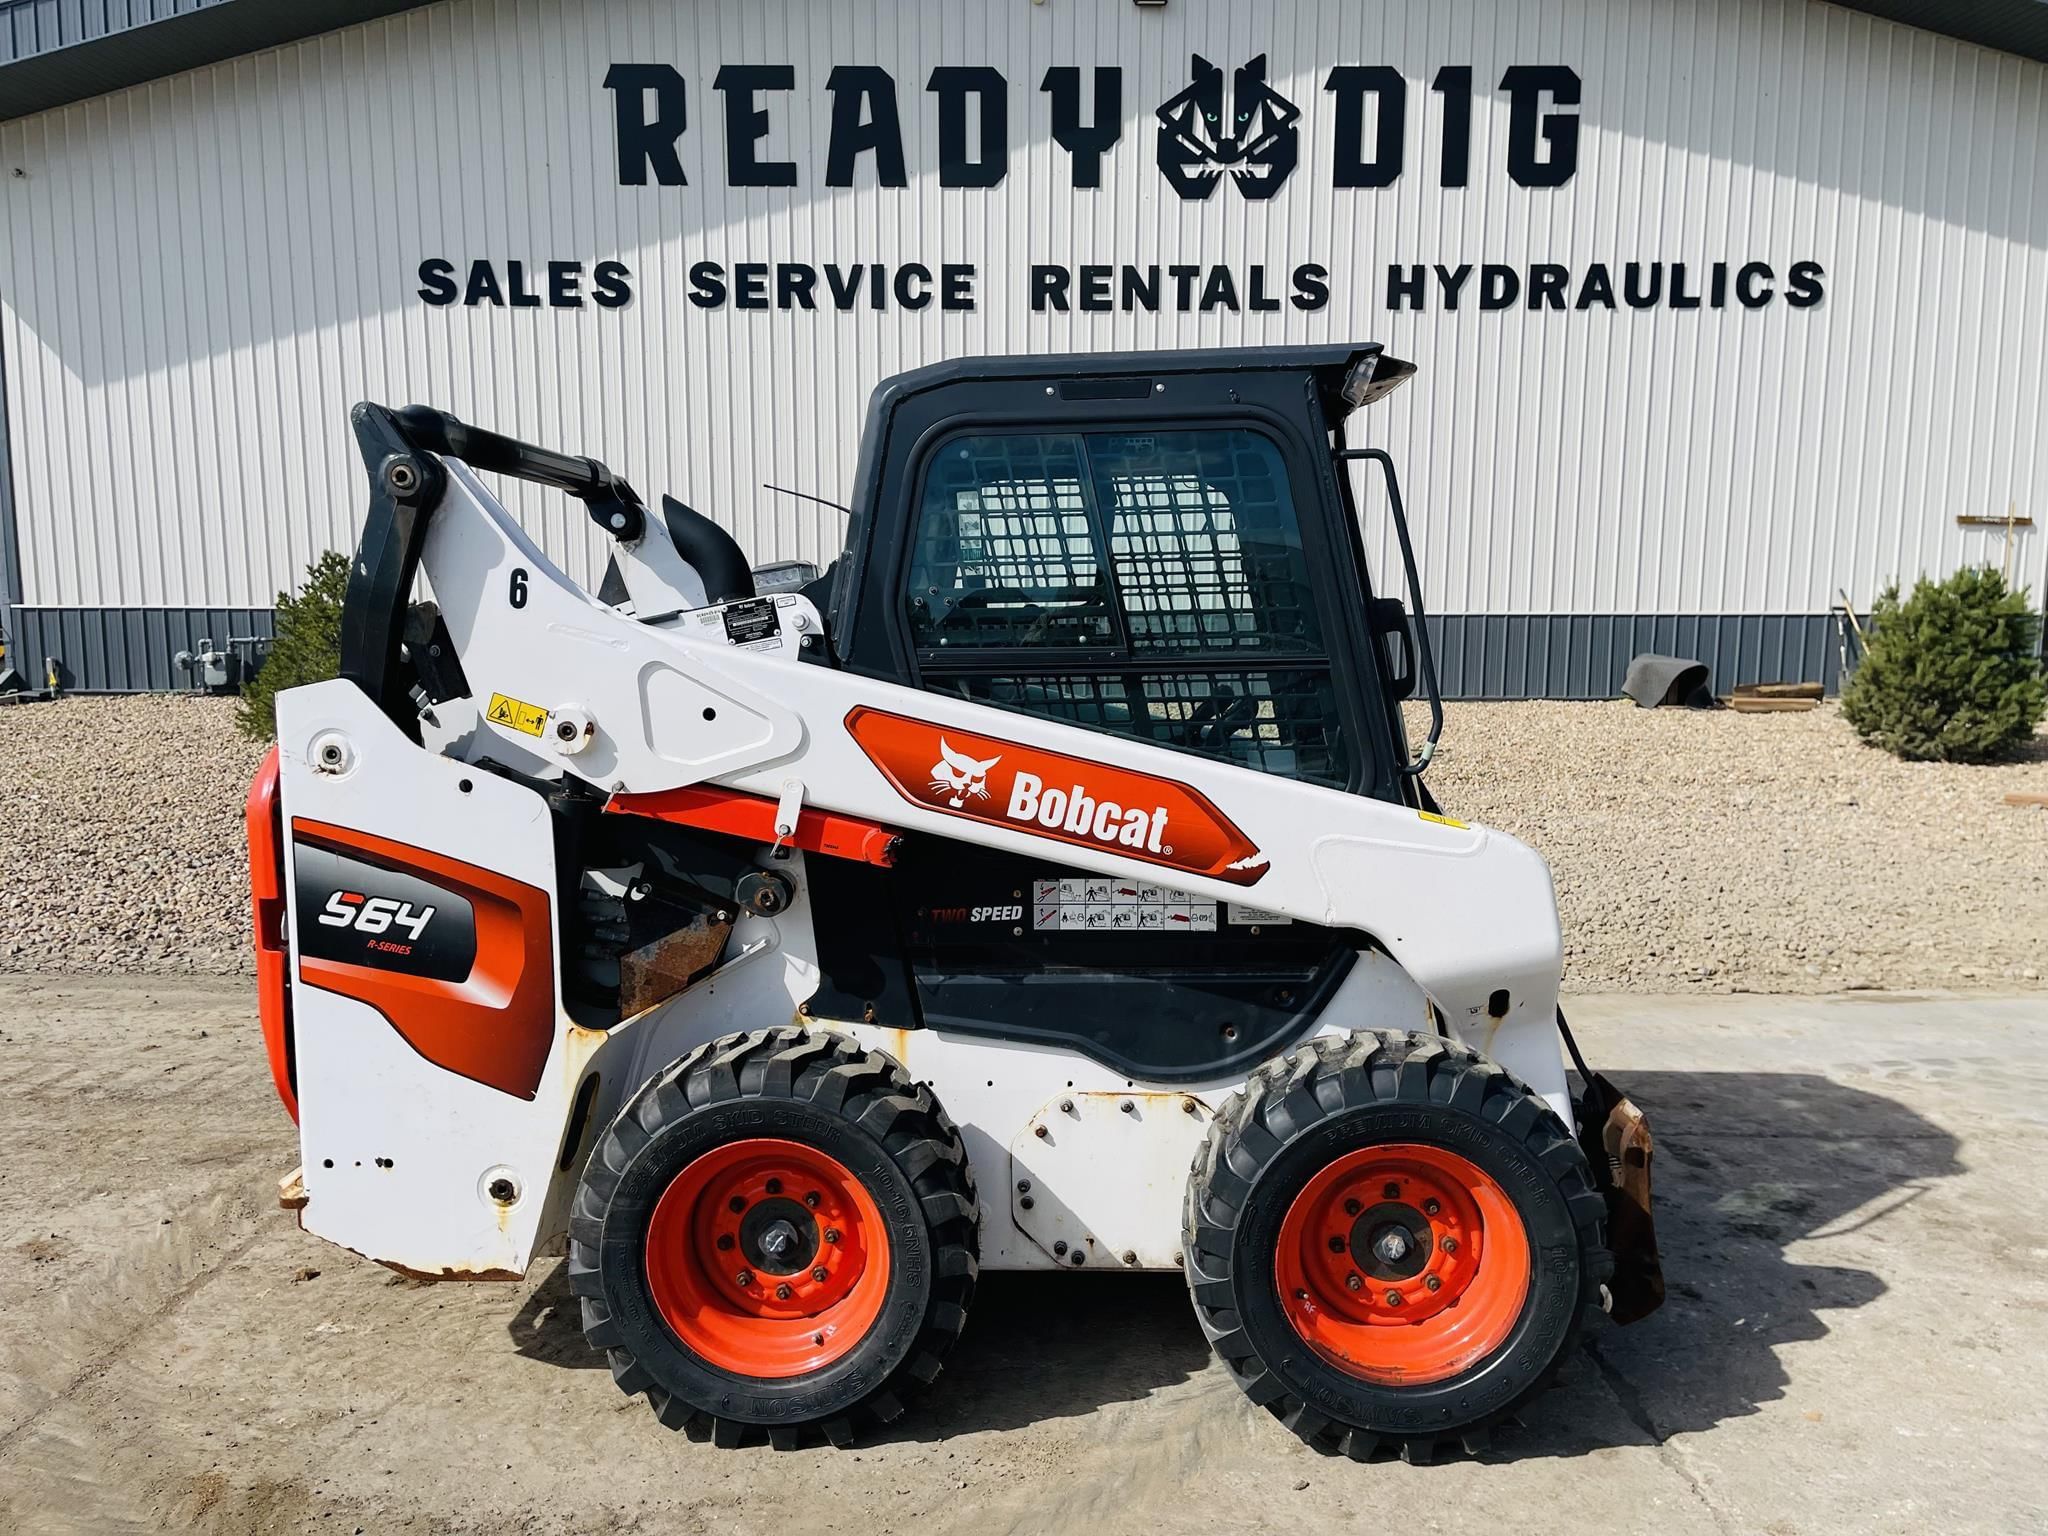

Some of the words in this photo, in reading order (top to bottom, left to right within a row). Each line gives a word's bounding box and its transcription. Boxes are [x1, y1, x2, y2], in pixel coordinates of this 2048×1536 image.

[603, 64, 1122, 188] READY
[1324, 66, 1582, 188] DIG
[418, 259, 631, 308] SALES
[688, 262, 975, 310] SERVICE
[1032, 264, 1330, 311] RENTALS
[1387, 262, 1824, 311] HYDRAULICS
[509, 567, 529, 609] 6
[1006, 770, 1168, 854] Bobcat
[318, 890, 436, 941] S64
[930, 907, 967, 922] TWO
[970, 905, 1023, 922] SPEED
[367, 939, 412, 955] R-SERIES
[711, 1108, 765, 1130] SKID
